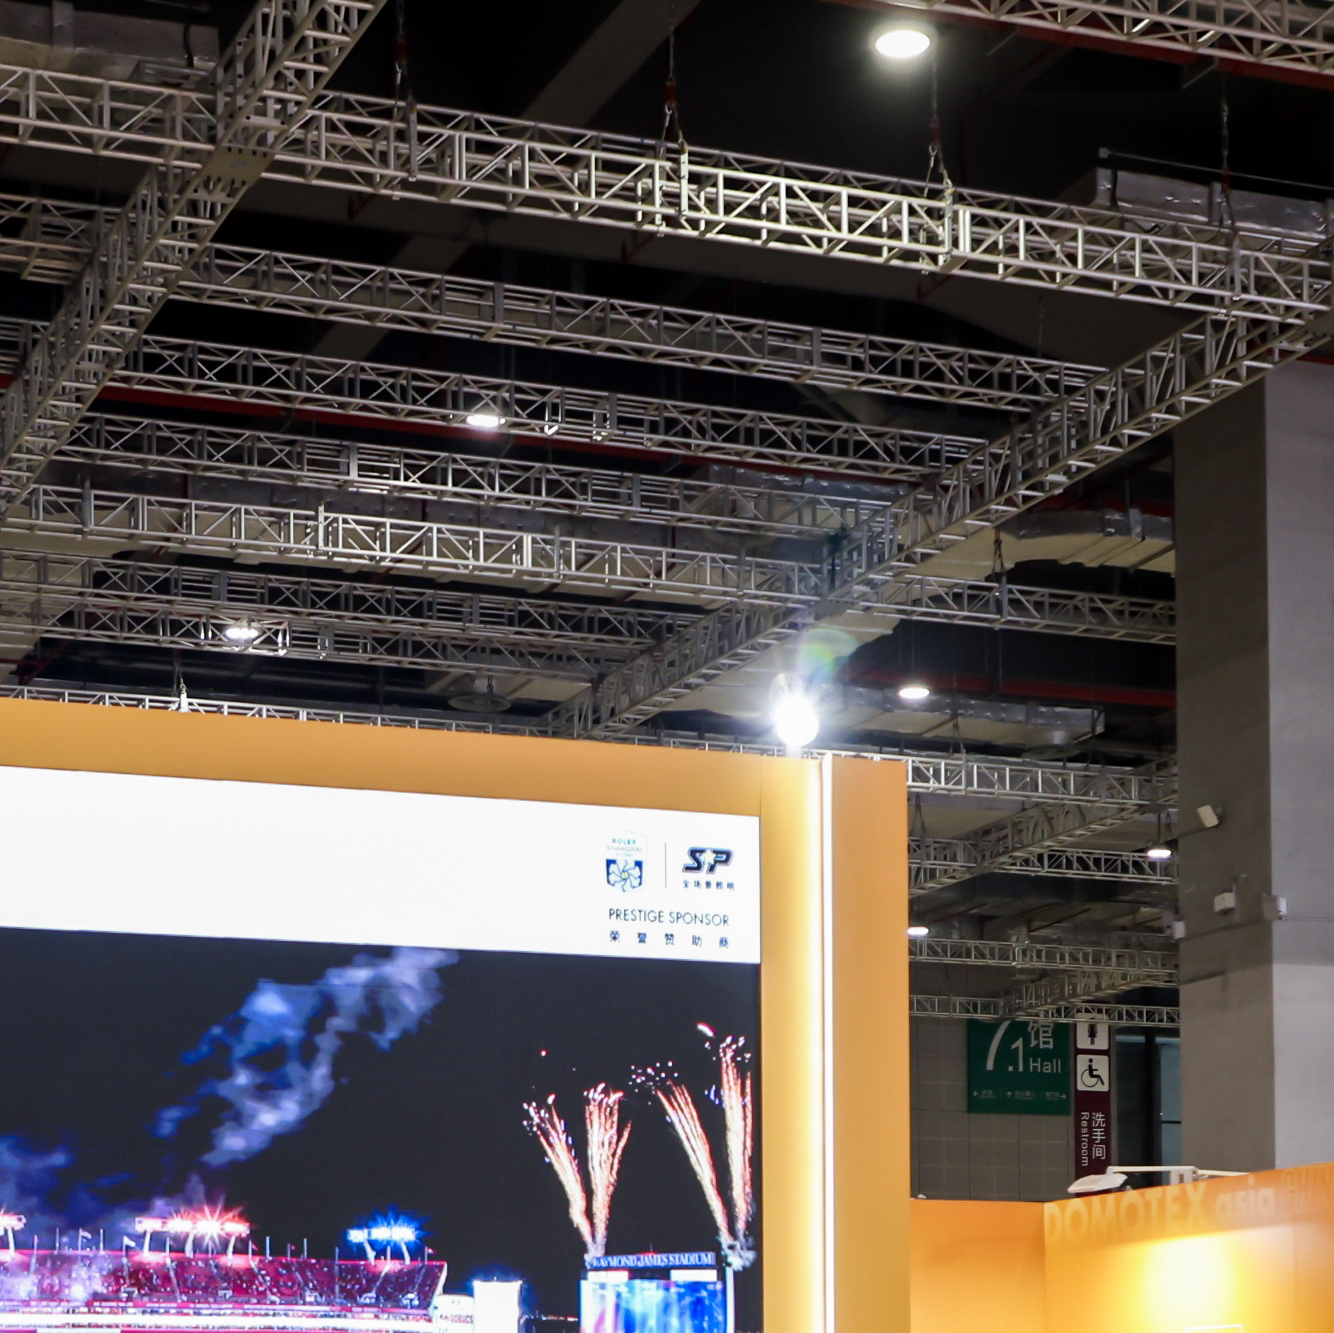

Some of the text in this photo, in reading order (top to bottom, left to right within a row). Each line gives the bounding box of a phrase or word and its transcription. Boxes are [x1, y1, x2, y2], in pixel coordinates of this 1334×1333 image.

[609, 907, 730, 927] PRESTIGE SPONSOR
[1028, 1020, 1054, 1049] 馆
[1029, 1058, 1061, 1073] Hall
[1080, 1112, 1088, 1167] Restroom
[1092, 1112, 1106, 1160] 洗手间
[1044, 1182, 1209, 1242] DOMOTEX
[1214, 1173, 1276, 1218] asia
[669, 1252, 713, 1266] STADIUM
